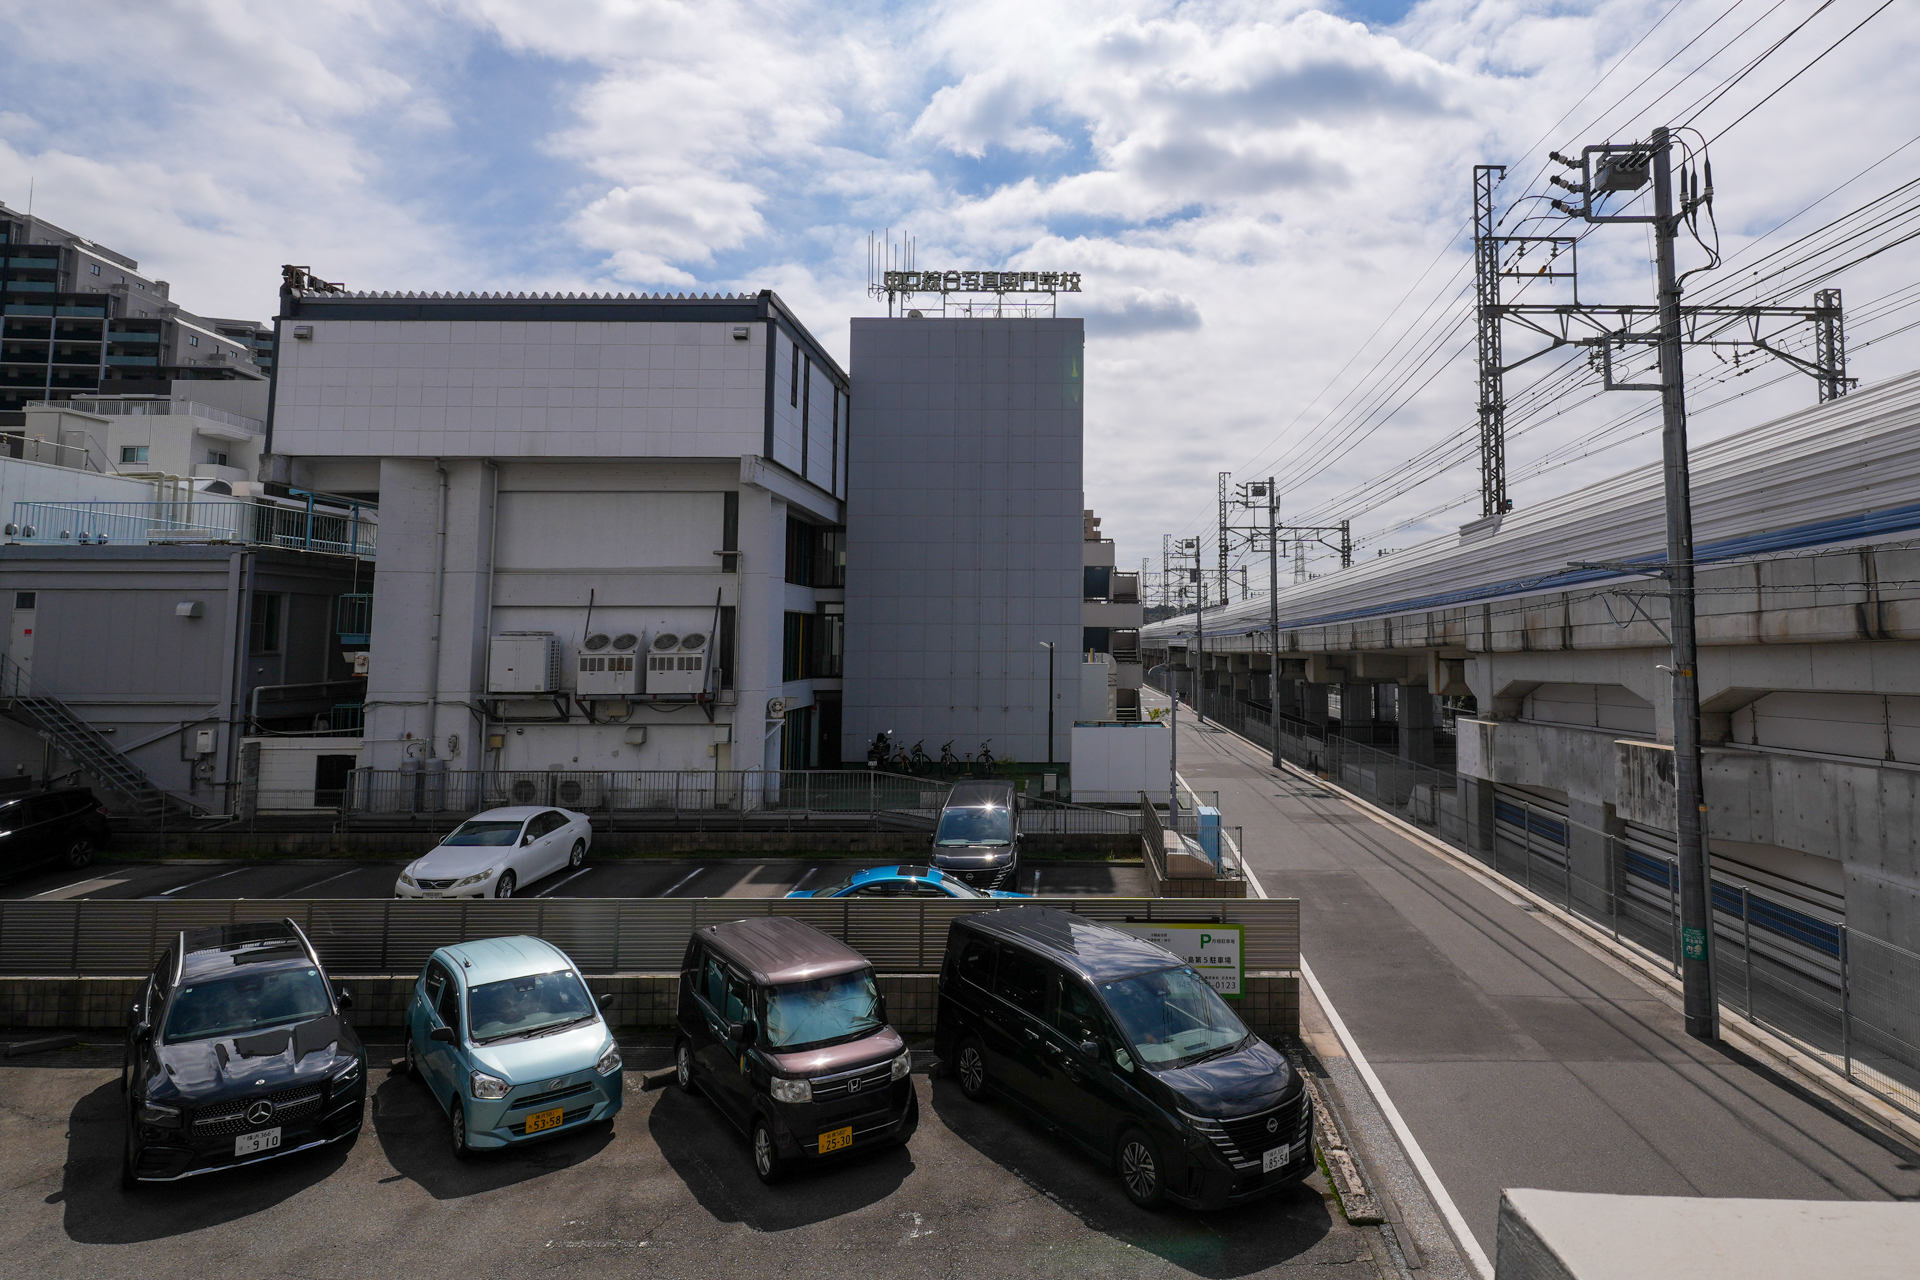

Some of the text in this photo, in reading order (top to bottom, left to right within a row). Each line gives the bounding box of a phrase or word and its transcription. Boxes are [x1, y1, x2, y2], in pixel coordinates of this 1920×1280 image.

[1200, 934, 1212, 949] P
[534, 1115, 561, 1130] 53-58
[826, 1135, 850, 1150] 25-30
[1269, 1152, 1288, 1168] 85-54
